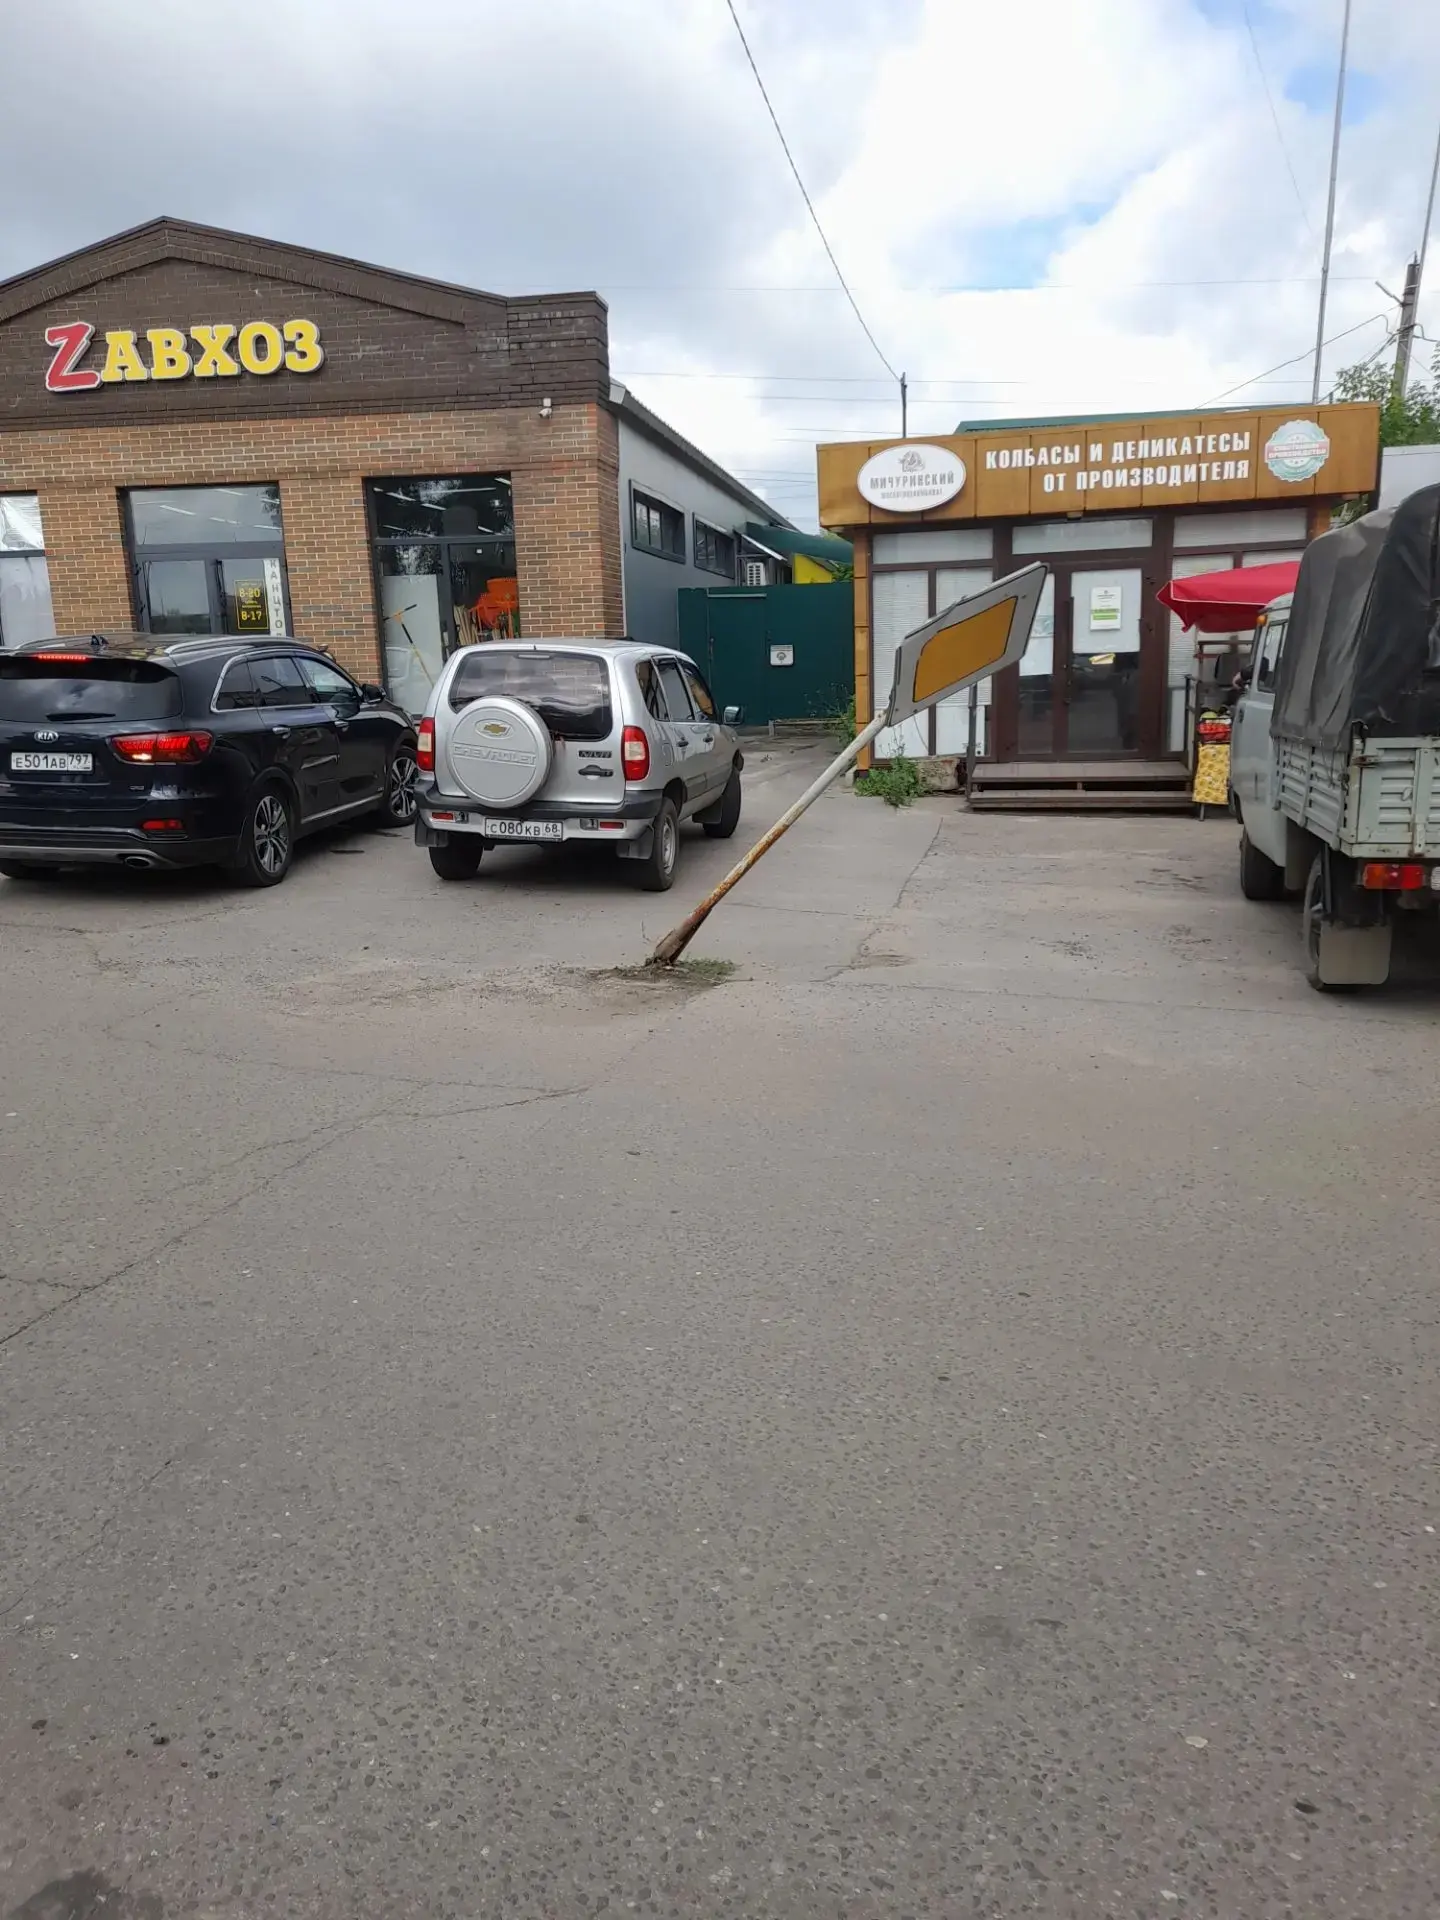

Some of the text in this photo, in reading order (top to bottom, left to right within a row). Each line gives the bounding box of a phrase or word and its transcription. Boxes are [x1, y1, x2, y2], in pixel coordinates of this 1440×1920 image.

[44, 319, 325, 392] ZАВХОЗ
[985, 431, 1251, 469] КОЛБАСЫ И ДЕЛИКАТЕСЫ
[1043, 459, 1250, 493] ОТ ПРОИЗВОДИТЕЛЯ
[270, 560, 283, 636] КАНЦТО
[37, 731, 54, 740] KIA
[68, 754, 89, 765] 797
[453, 745, 536, 765] CHEVROLET
[544, 823, 558, 834] 68
